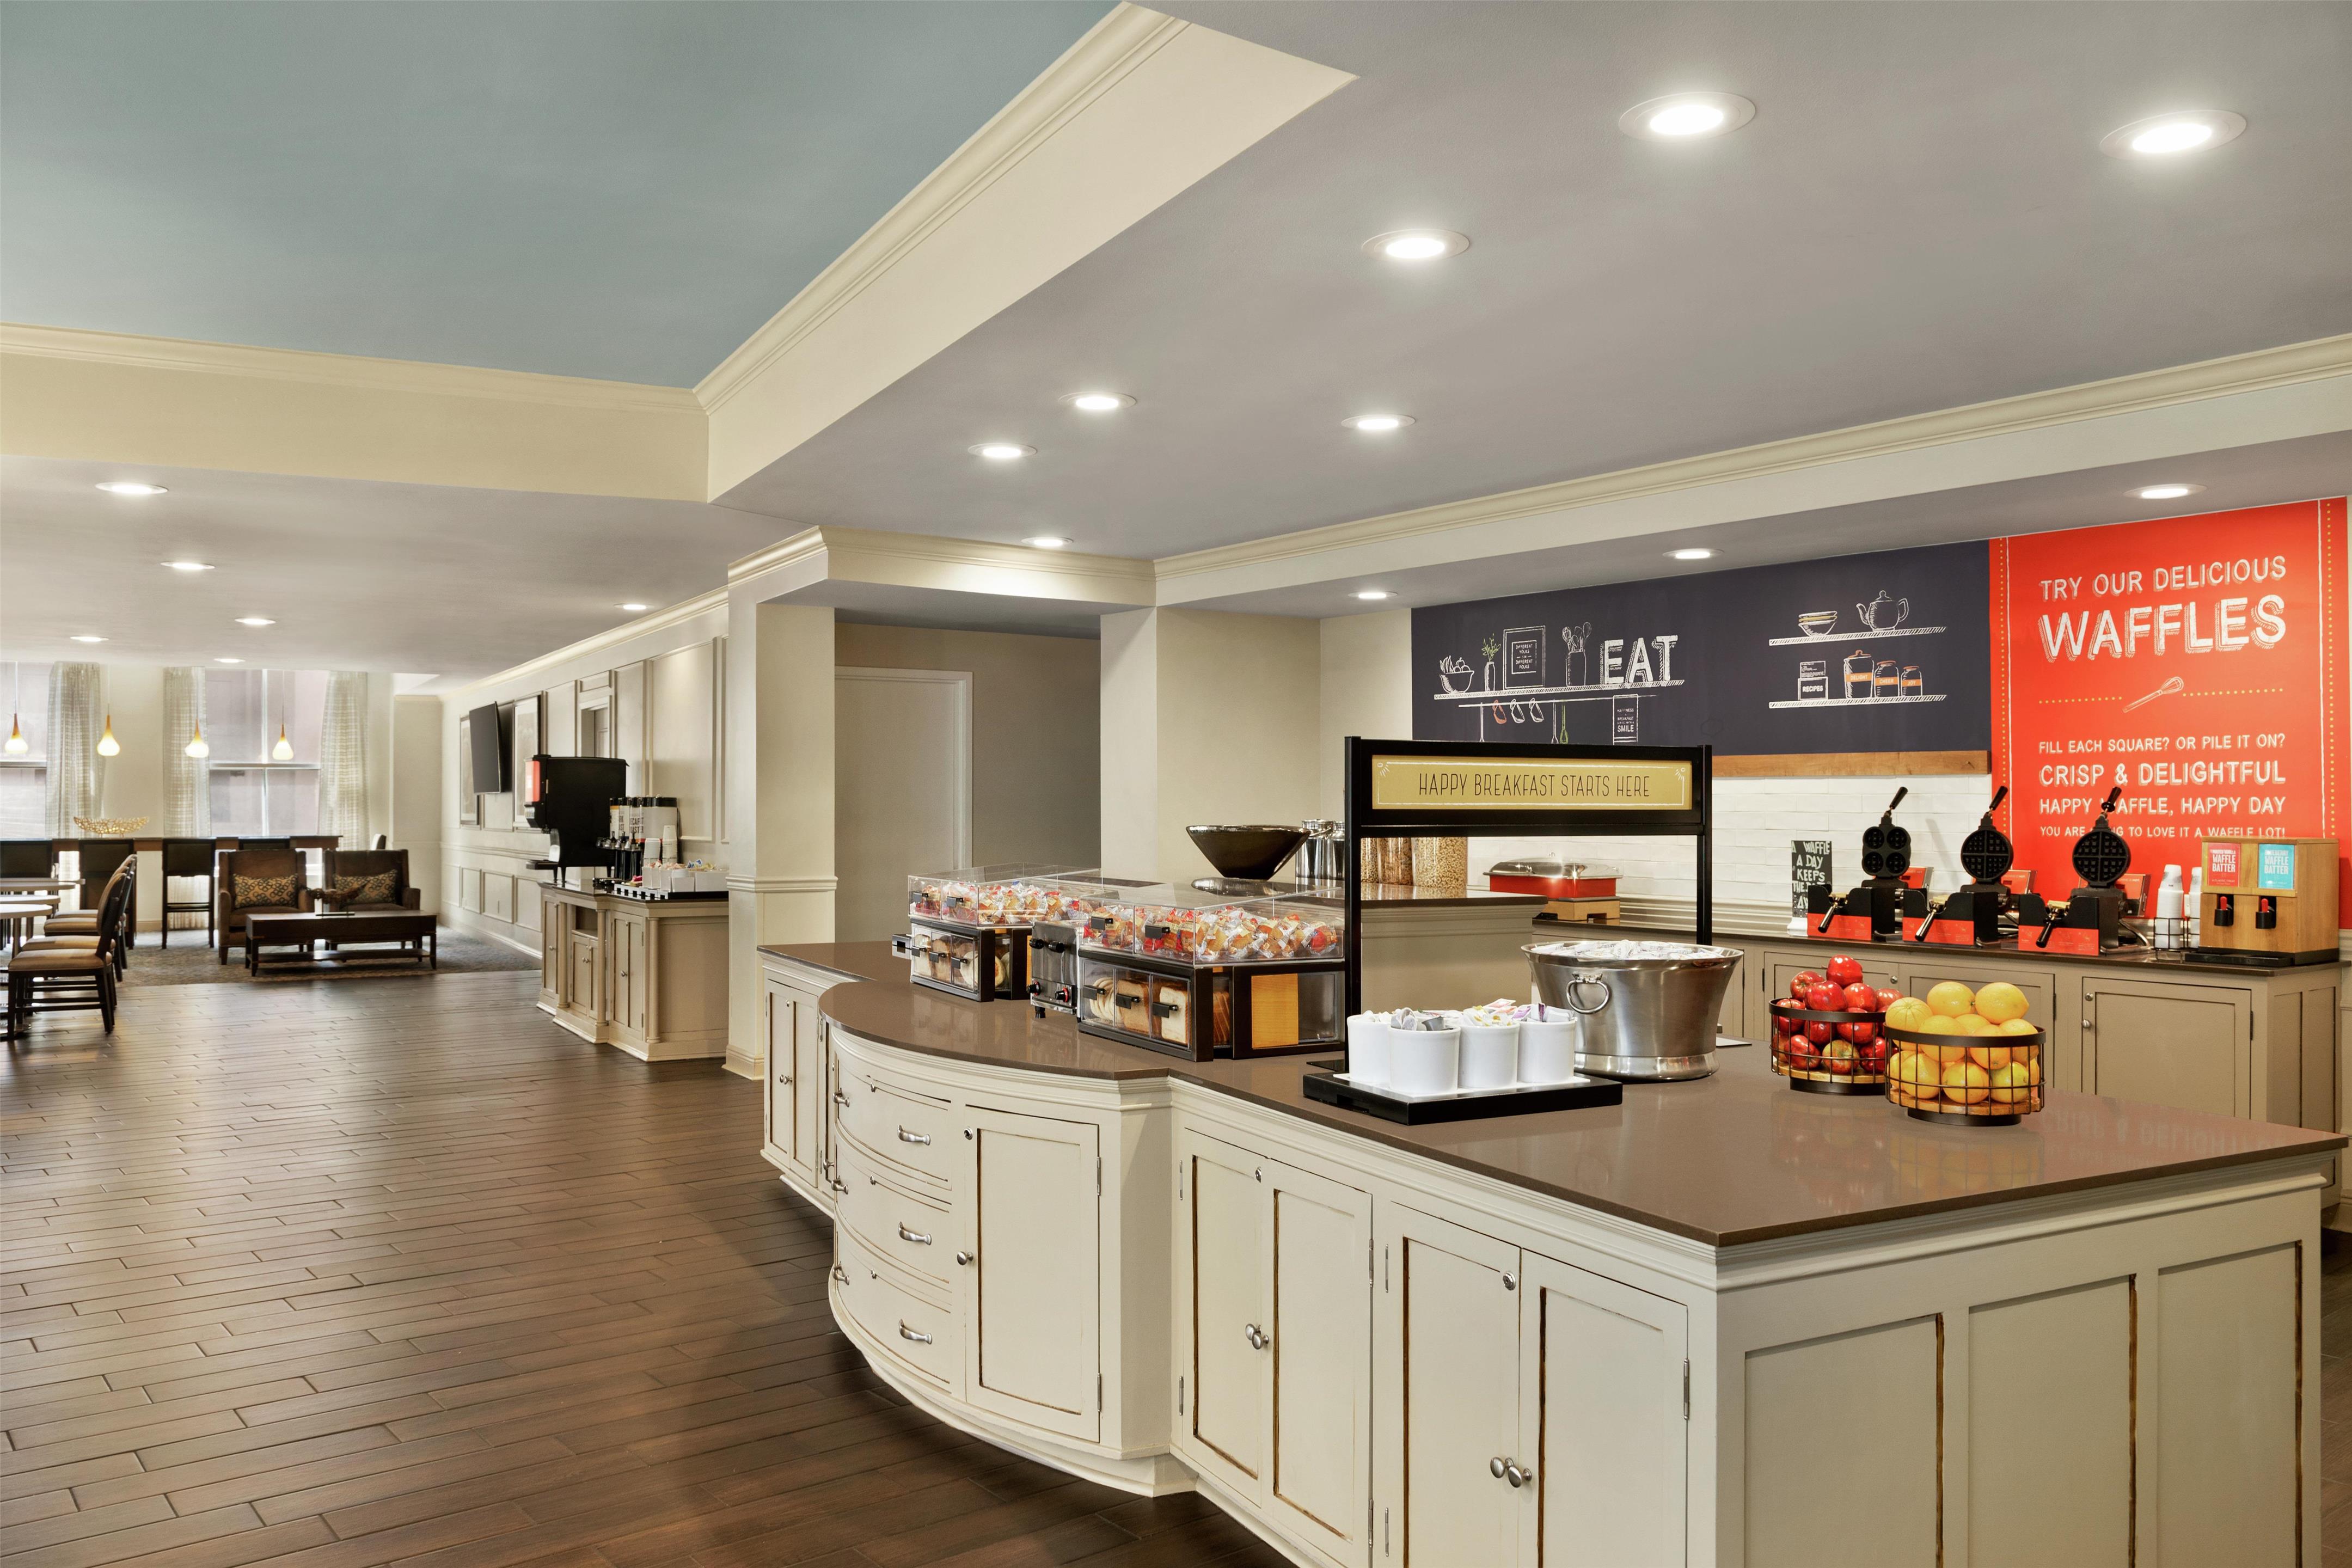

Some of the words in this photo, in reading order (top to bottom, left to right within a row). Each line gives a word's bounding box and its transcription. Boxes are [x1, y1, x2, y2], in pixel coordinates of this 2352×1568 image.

[2039, 577, 2082, 602] TRY
[2093, 571, 2143, 597] OUR
[2153, 555, 2287, 591] DELICIOUS
[2038, 594, 2287, 663] WAFFLES
[1601, 635, 1678, 685] EAT
[1802, 685, 1824, 693] RECIPES
[1617, 724, 1634, 732] SMILE
[2039, 740, 2063, 754] FILL
[2068, 740, 2102, 753] EACH
[2108, 737, 2170, 752] SQUARE?
[2176, 736, 2196, 750] OR
[2202, 735, 2232, 749] PILE
[2237, 734, 2250, 748] IT
[2257, 733, 2286, 748] ON?
[2039, 764, 2105, 786] CRISP
[2114, 763, 2129, 786] &
[2137, 760, 2287, 786] DELIGHTFUL
[1419, 773, 1468, 796] HAPPY
[1474, 774, 1556, 797] BREAKFAST
[1560, 775, 1610, 797] STARTS
[1616, 775, 1650, 797] HERE
[2039, 798, 2092, 814] HAPPY
[2099, 797, 2173, 816] AFFLE,
[2180, 797, 2241, 814] HAPPY
[2249, 796, 2287, 814] DAY
[2041, 826, 2061, 837] YOU
[2065, 826, 2085, 837] ARE
[2128, 826, 2142, 837] TO
[2147, 826, 2176, 837] LOVE
[2179, 826, 2190, 837] IT
[2194, 826, 2203, 837] A
[2208, 826, 2254, 837] WAFFLE
[2258, 826, 2286, 838] LOT!
[1791, 841, 1797, 853] A
[1803, 840, 1830, 854] WAFFLE
[1796, 854, 1803, 866] A
[1806, 854, 1823, 869] DAY
[2212, 854, 2236, 863] WAFFLE
[2265, 855, 2289, 865] WAFFLE
[1797, 868, 1826, 882] KEEPS
[2212, 863, 2236, 873] BATTER
[2264, 865, 2289, 875] BATTER
